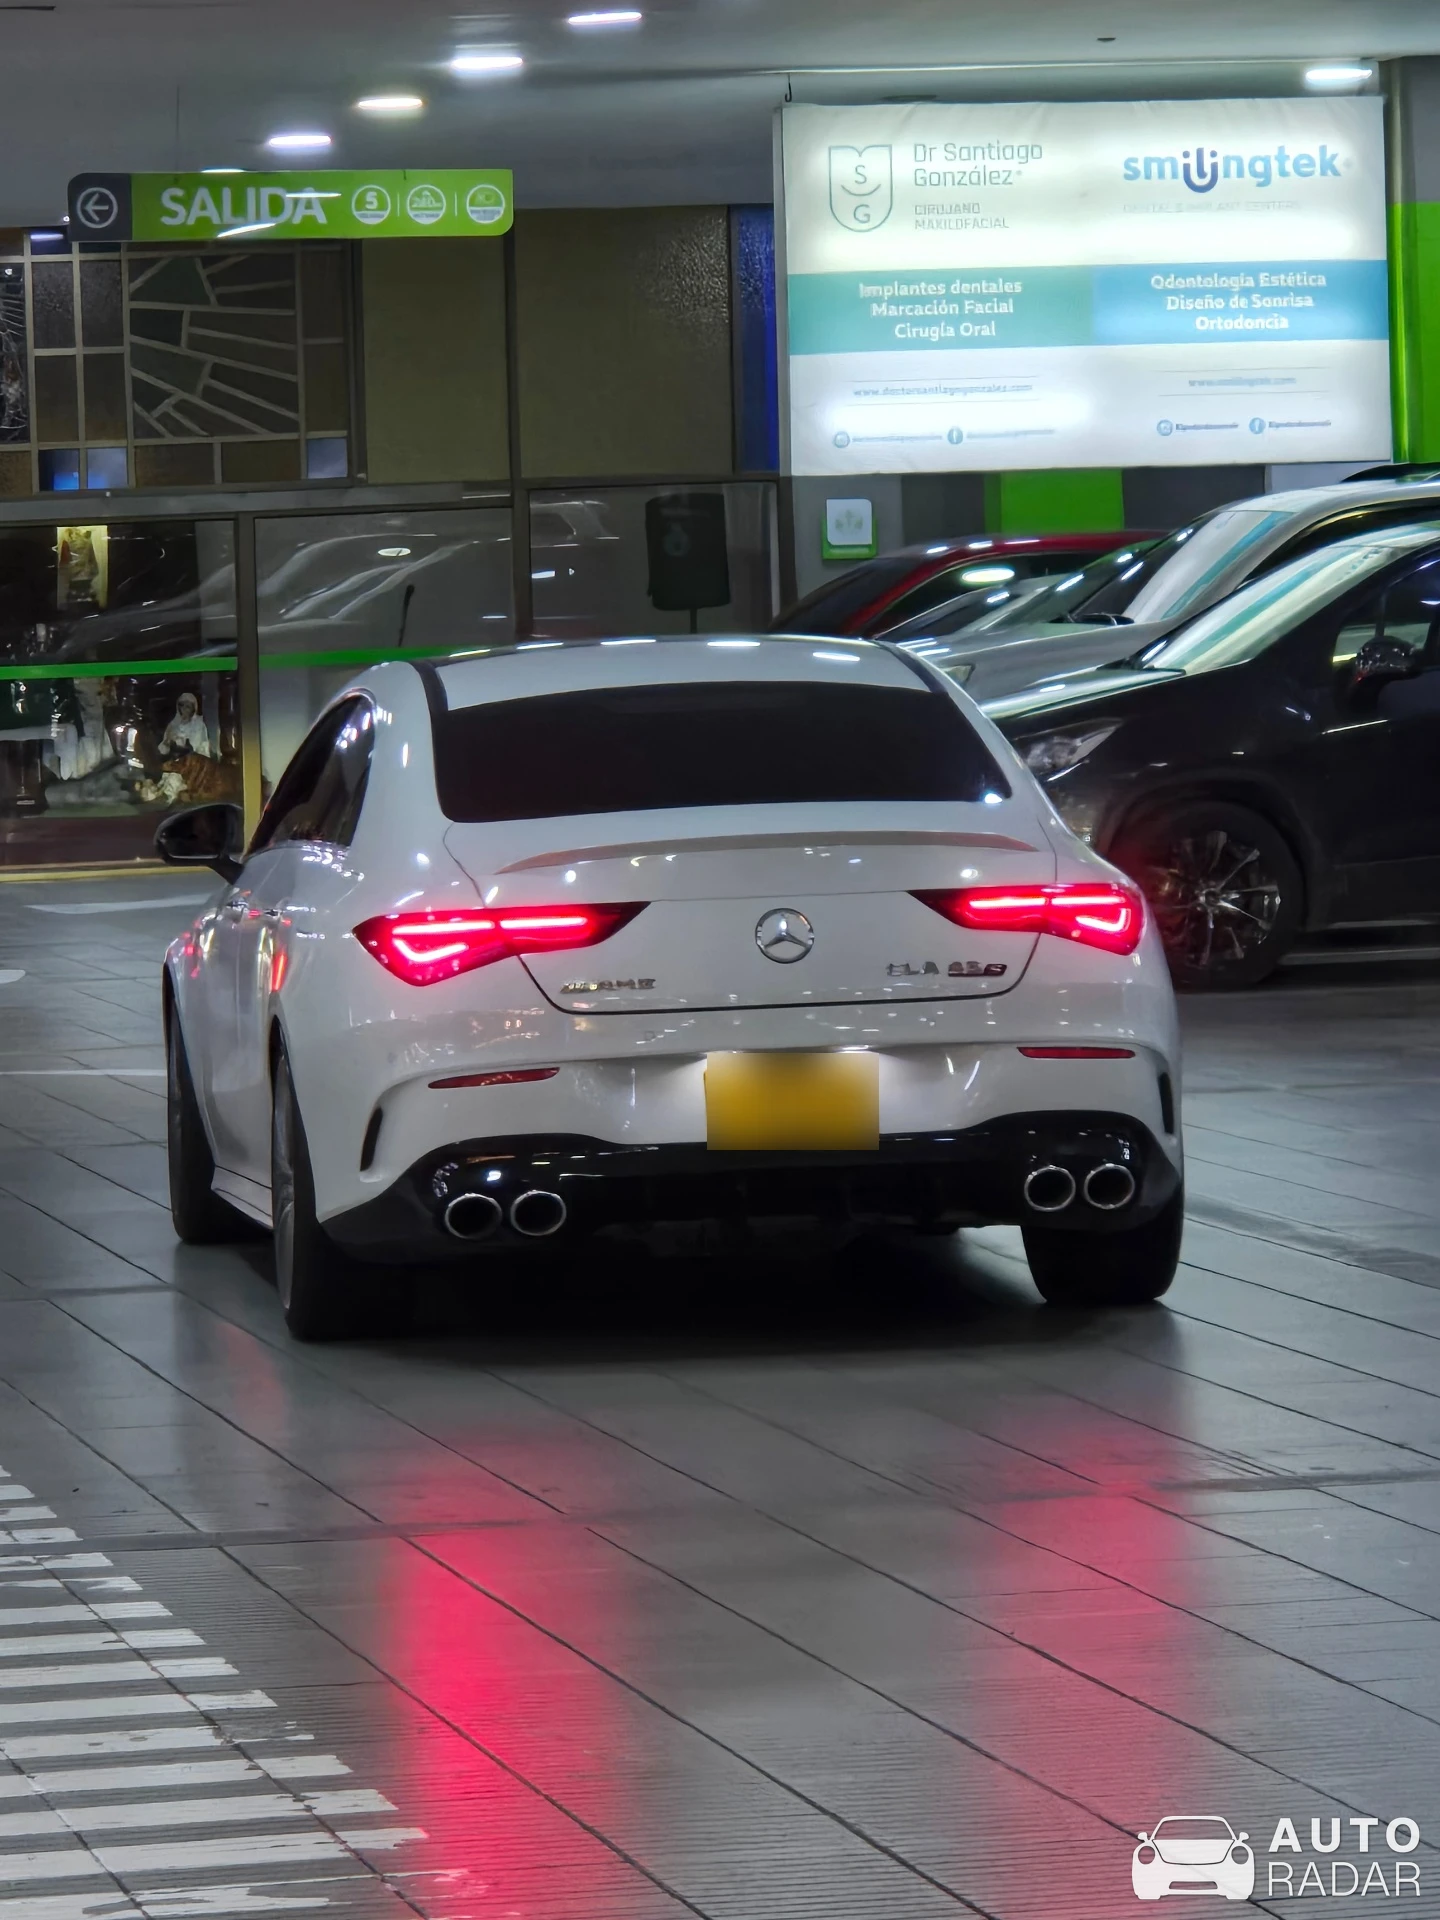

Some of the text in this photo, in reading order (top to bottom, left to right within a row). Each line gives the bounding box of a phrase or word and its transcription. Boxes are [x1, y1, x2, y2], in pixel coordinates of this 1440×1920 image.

[914, 139, 1043, 164] Dr Santiago
[913, 165, 1014, 187] González
[1122, 145, 1342, 194] smilingtek
[160, 186, 328, 226] SALIDA
[914, 202, 981, 215] CIRUJANO
[914, 217, 1010, 231] MAXILOFACIAL
[859, 277, 1023, 300] Implantes dentales
[1150, 271, 1327, 291] Odontología Estética
[871, 297, 1014, 316] Marcación Facial
[1166, 292, 1314, 311] Diseño de Sonrisa
[894, 320, 996, 342] Cirugía Oral
[1195, 313, 1289, 331] Ortodoncia
